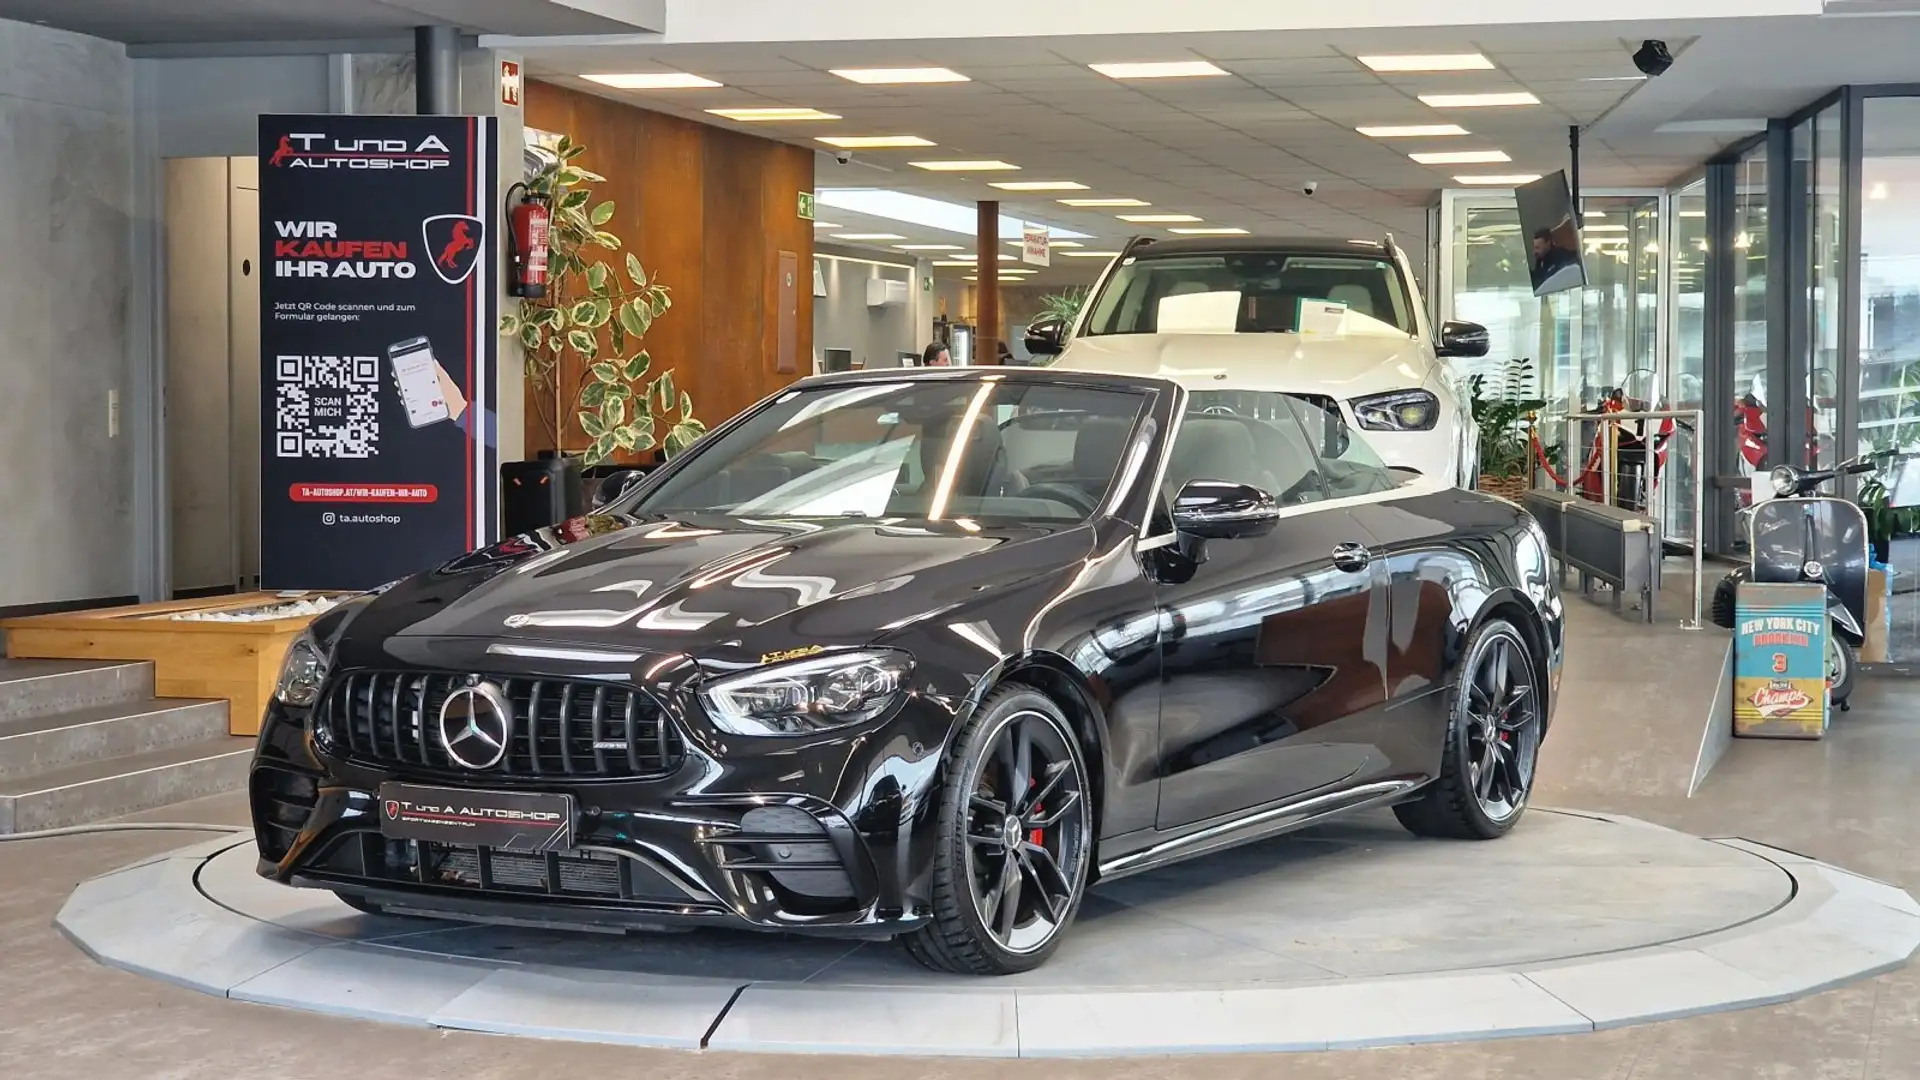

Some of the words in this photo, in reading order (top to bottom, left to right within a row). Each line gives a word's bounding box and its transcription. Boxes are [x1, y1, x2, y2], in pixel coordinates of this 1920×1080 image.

[289, 133, 325, 151] T
[414, 135, 450, 152] A
[289, 158, 450, 170] AUTOSHOP
[274, 221, 337, 237] WIR
[274, 240, 407, 259] KAUFEN
[275, 261, 329, 278] IHR
[331, 261, 417, 279] AUTO
[274, 302, 296, 311] Jetzt
[297, 302, 312, 311] QR
[313, 302, 336, 311] Code
[338, 303, 376, 312] scannen
[376, 303, 395, 312] und
[396, 304, 416, 312] zum
[274, 312, 315, 321] Formular
[316, 313, 361, 323] gelangen:
[314, 397, 342, 406] SCAN
[314, 408, 342, 417] MICH
[339, 514, 401, 525] ta.autoshop
[1742, 619, 1764, 635] NEW
[1766, 617, 1794, 630] YORK
[1795, 619, 1820, 636] CITY
[1772, 652, 1787, 673] 3
[401, 801, 412, 810] T
[443, 805, 455, 814] A
[460, 806, 560, 820] AUTOSHOP
